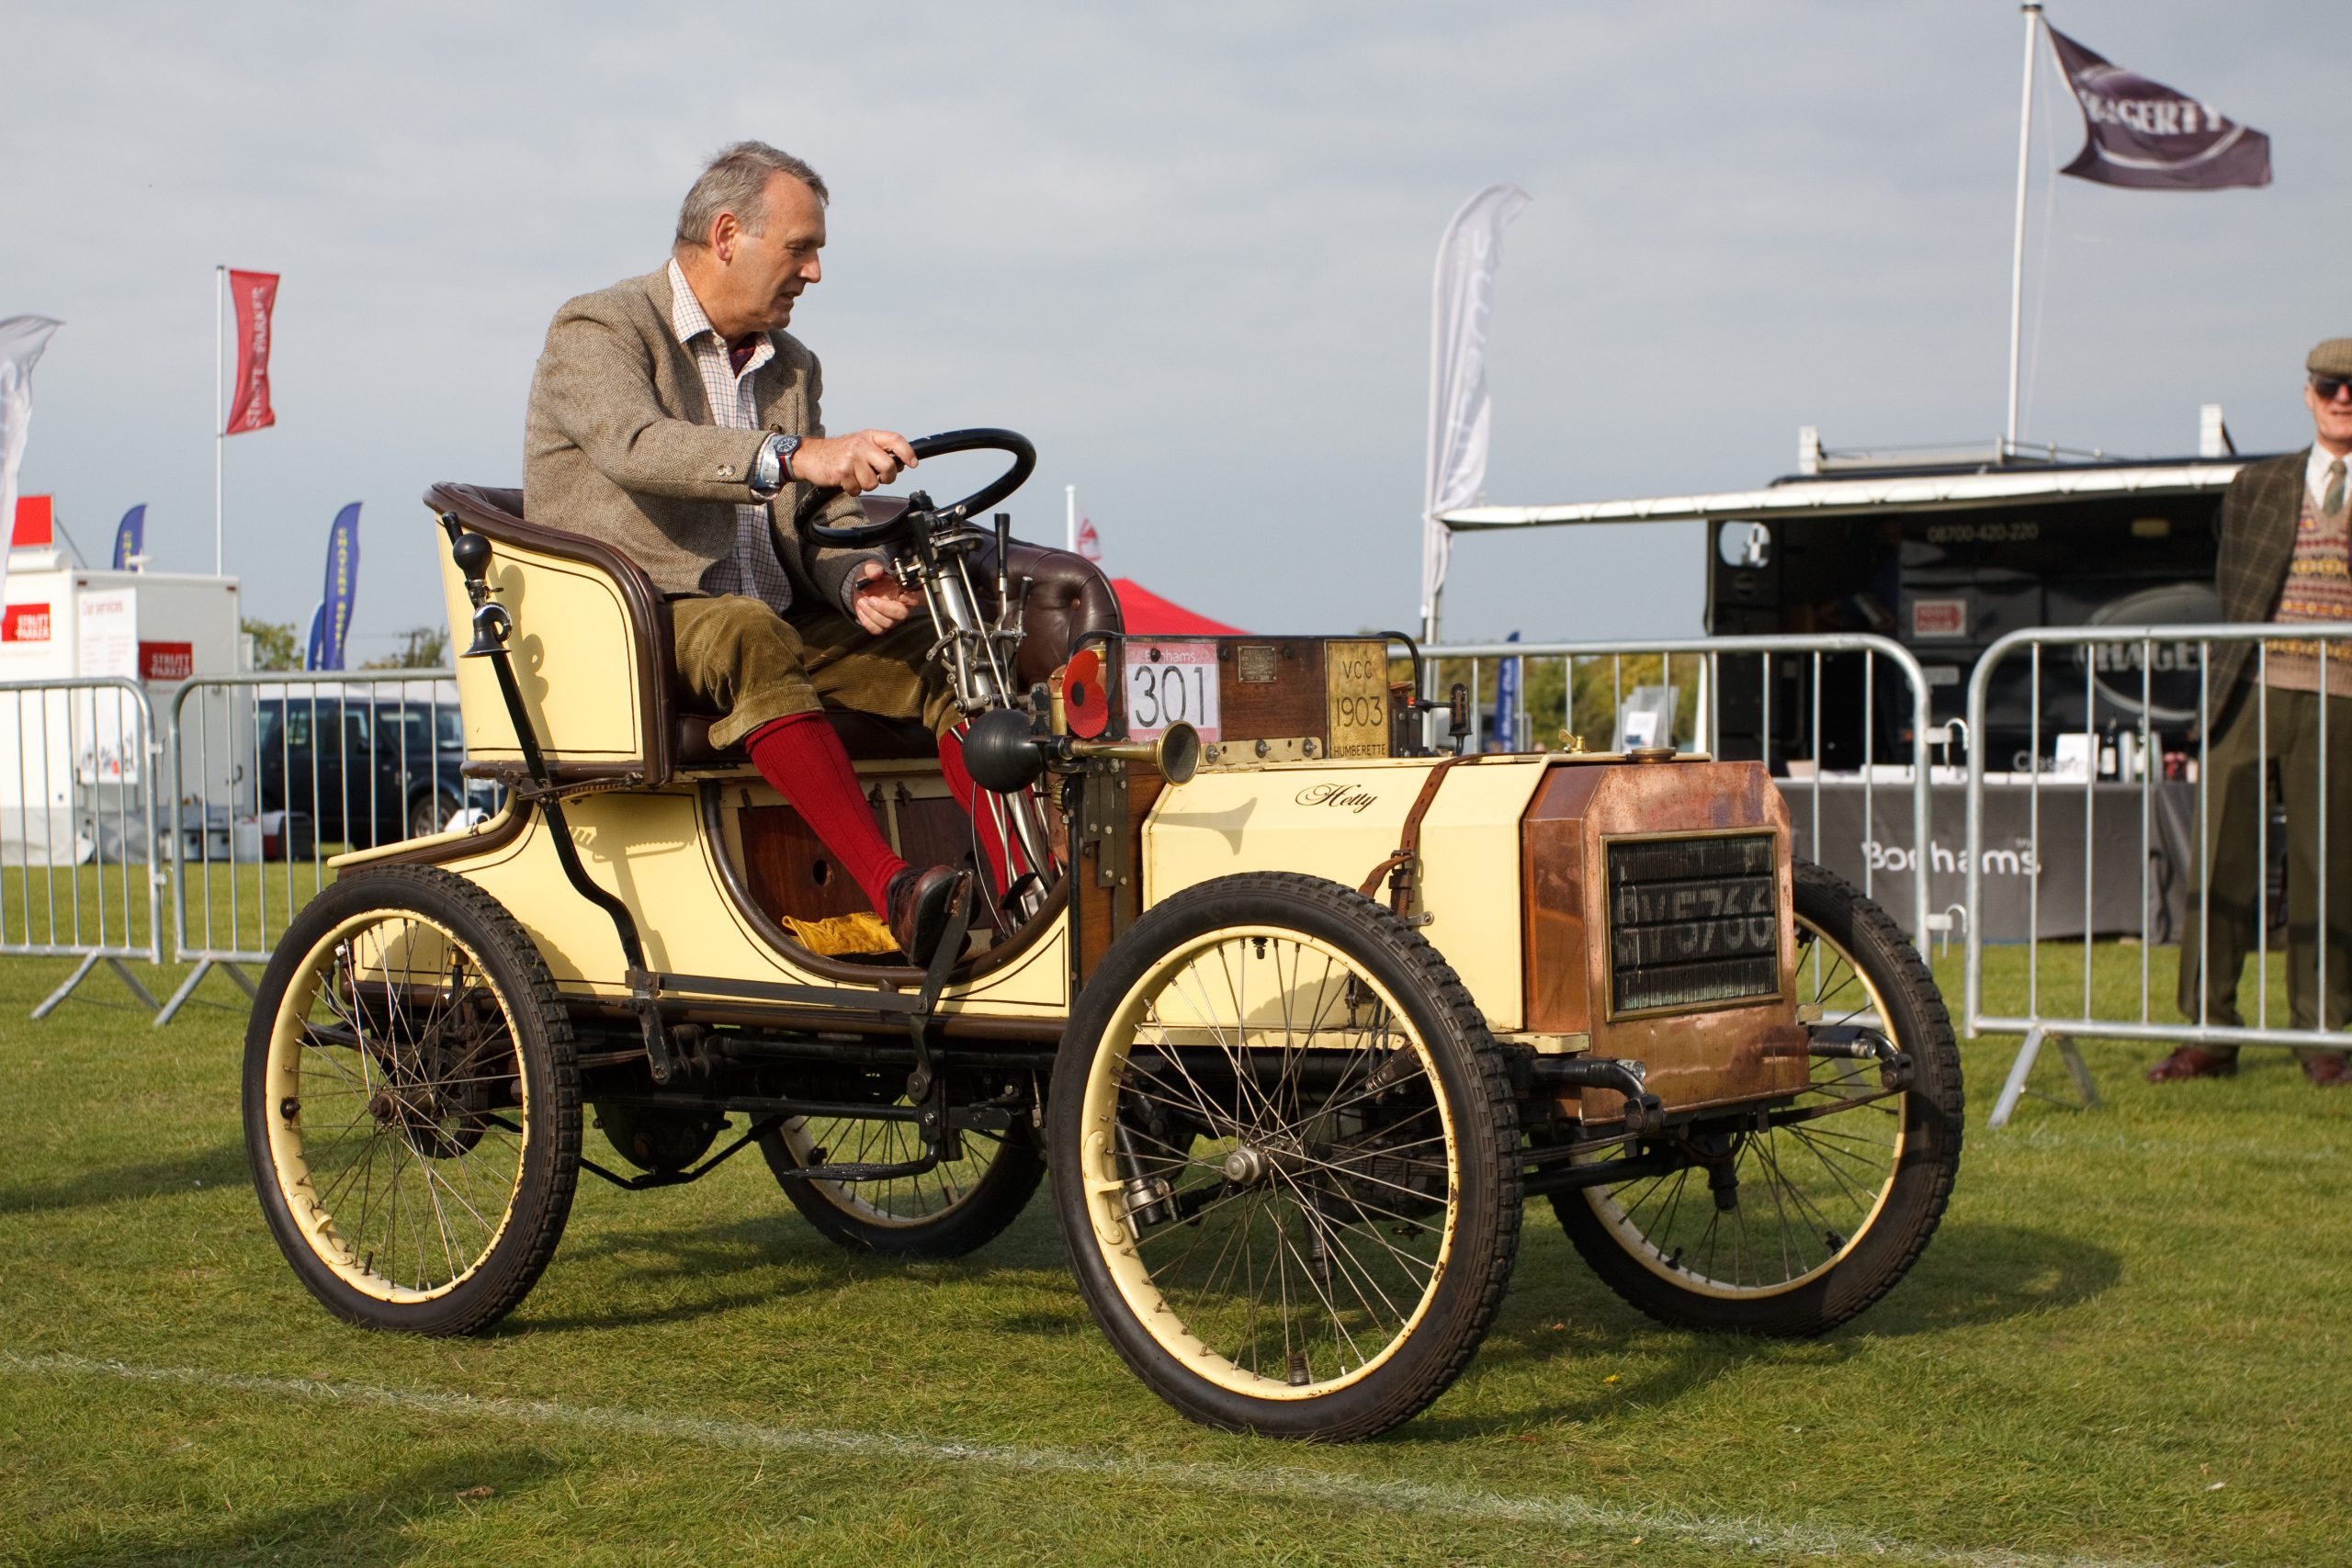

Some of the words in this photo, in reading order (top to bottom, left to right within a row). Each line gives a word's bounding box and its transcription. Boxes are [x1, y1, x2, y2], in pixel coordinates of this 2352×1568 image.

[1145, 649, 1196, 662] Bnhams
[1342, 660, 1373, 679] VCC
[1135, 665, 1204, 728] 301
[1337, 695, 1383, 728] 1903
[1333, 743, 1386, 757] HUMBERETTE
[1295, 783, 1378, 814] Hetty
